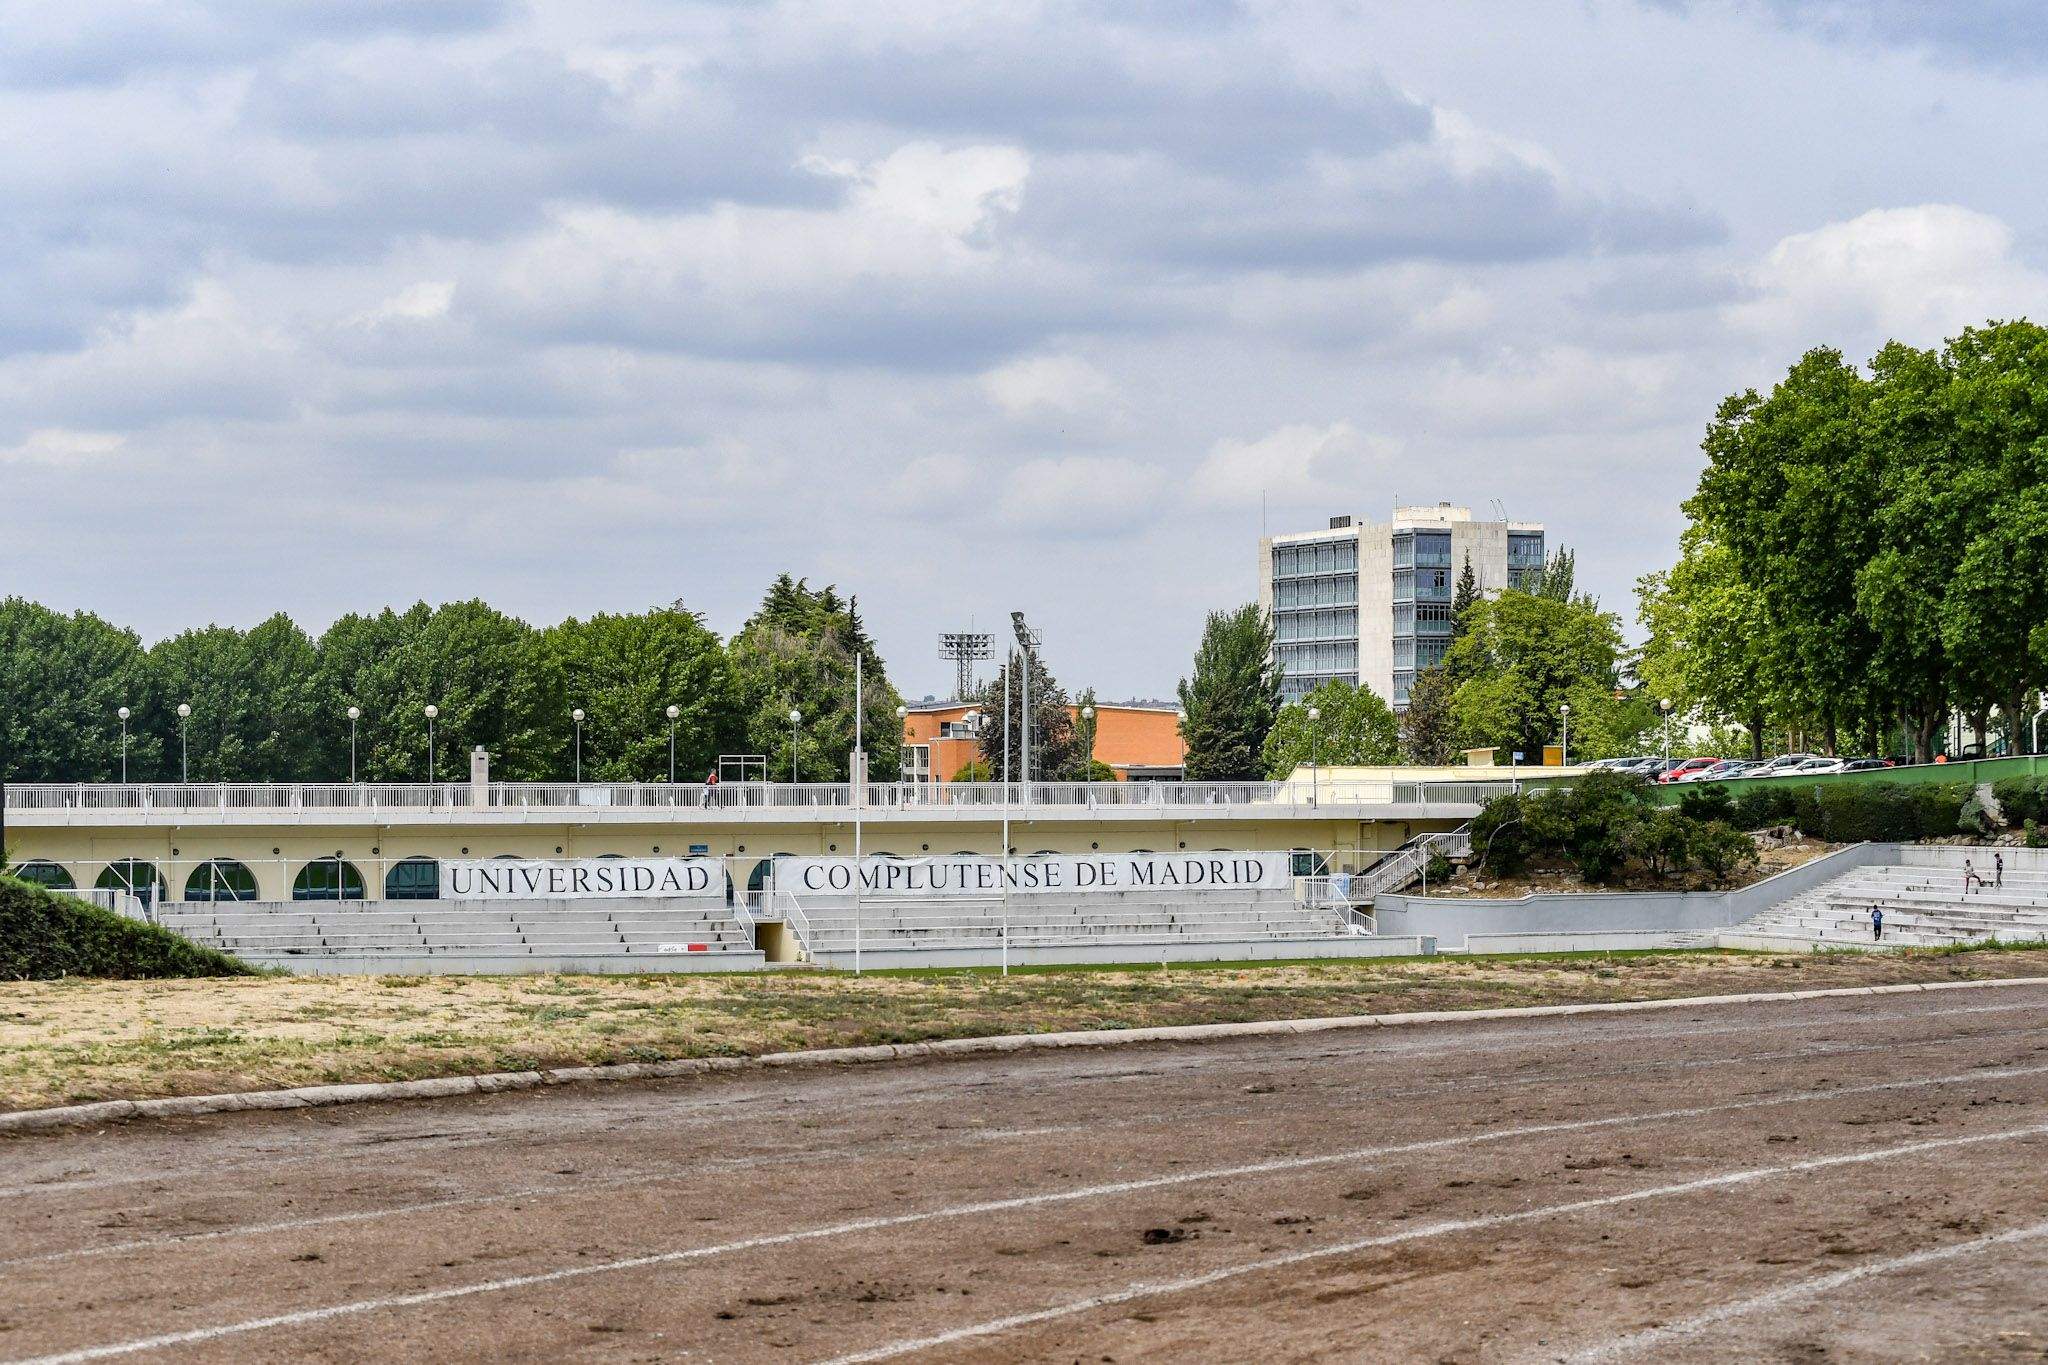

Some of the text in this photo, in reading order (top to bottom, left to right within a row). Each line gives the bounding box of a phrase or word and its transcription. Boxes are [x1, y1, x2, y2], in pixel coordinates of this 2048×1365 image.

[451, 866, 709, 894] UNIVERSIDAD
[803, 859, 1264, 890] COMPLUTENSE DE MADRID
